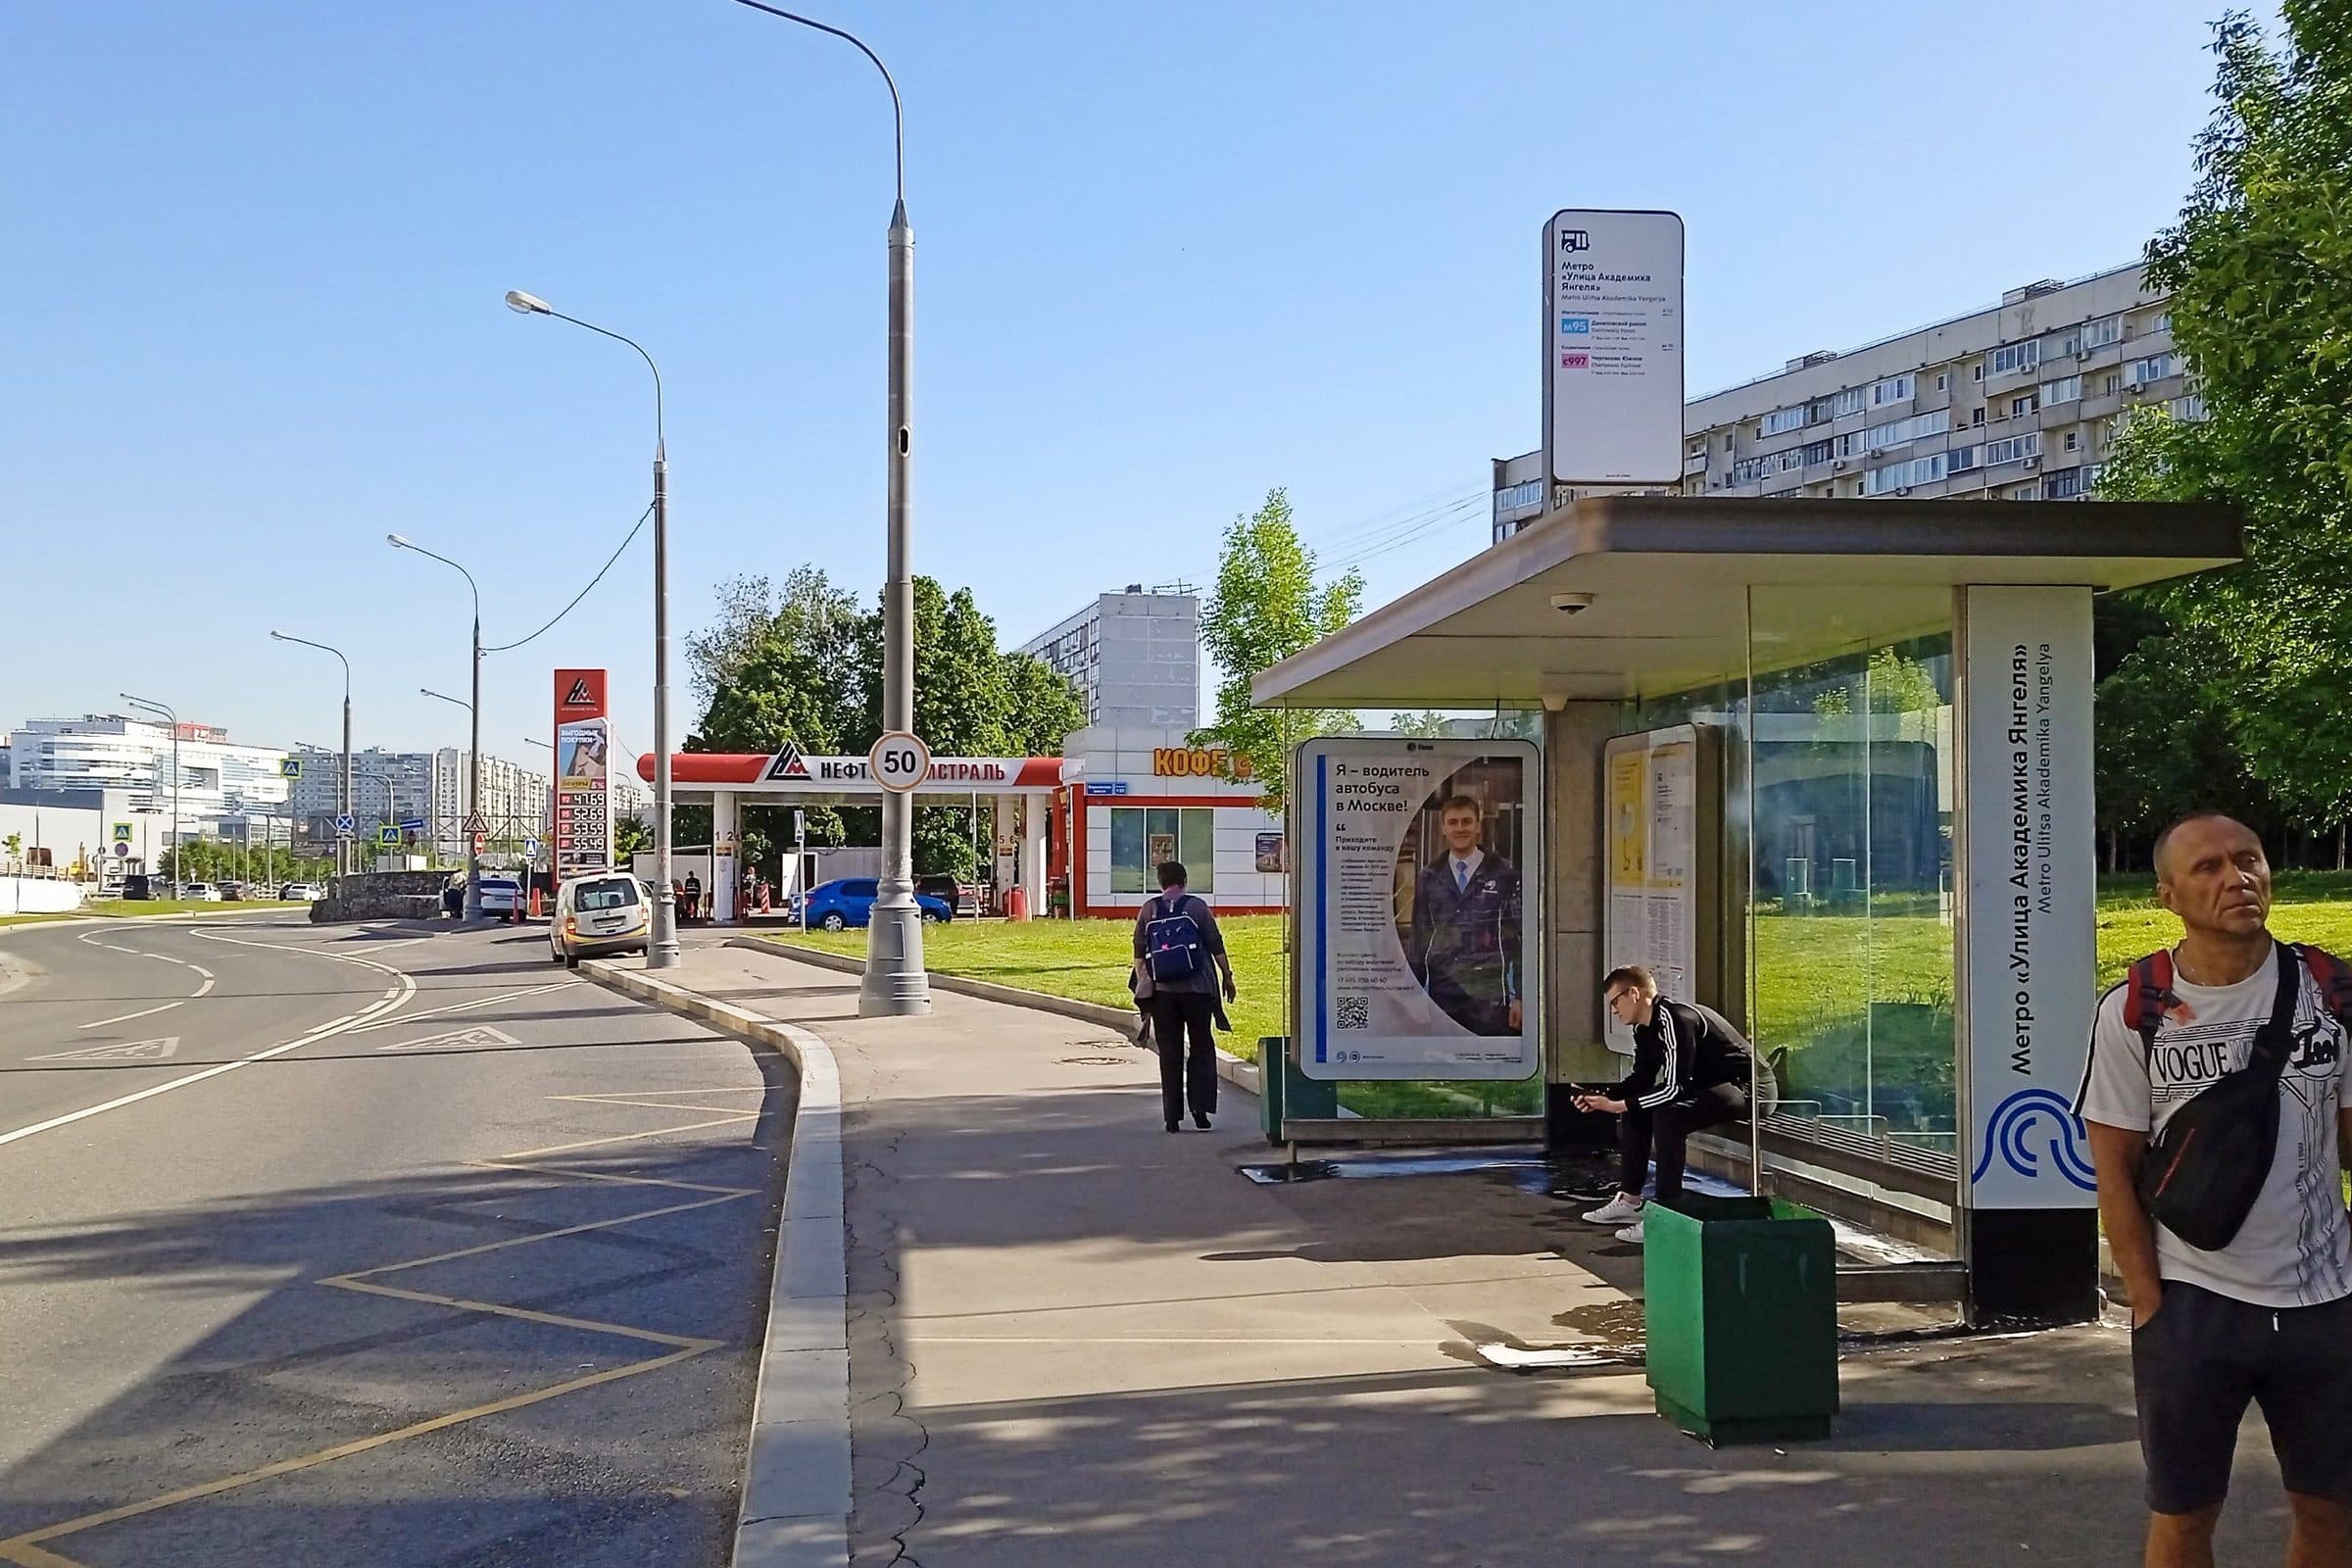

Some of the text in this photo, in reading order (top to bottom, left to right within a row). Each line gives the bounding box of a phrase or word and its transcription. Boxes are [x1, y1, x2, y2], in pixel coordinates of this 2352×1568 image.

[1562, 262, 1594, 271] Метро
[1562, 272, 1651, 282] «Улица Академика
[1562, 282, 1601, 291] Янгеля»
[884, 751, 916, 773] 50
[1153, 748, 1227, 777] КОФЕ
[1336, 763, 1347, 776] Я
[1362, 766, 1430, 778] водитель
[2035, 642, 2053, 913] Metro Ulitsa Akademika Yangelya
[1336, 781, 1400, 797] автобуса
[1336, 799, 1408, 812] в Москве!
[2009, 643, 2034, 1075] Метро «Улица Академика Янгеля»
[2153, 1042, 2231, 1082] VOGUE
